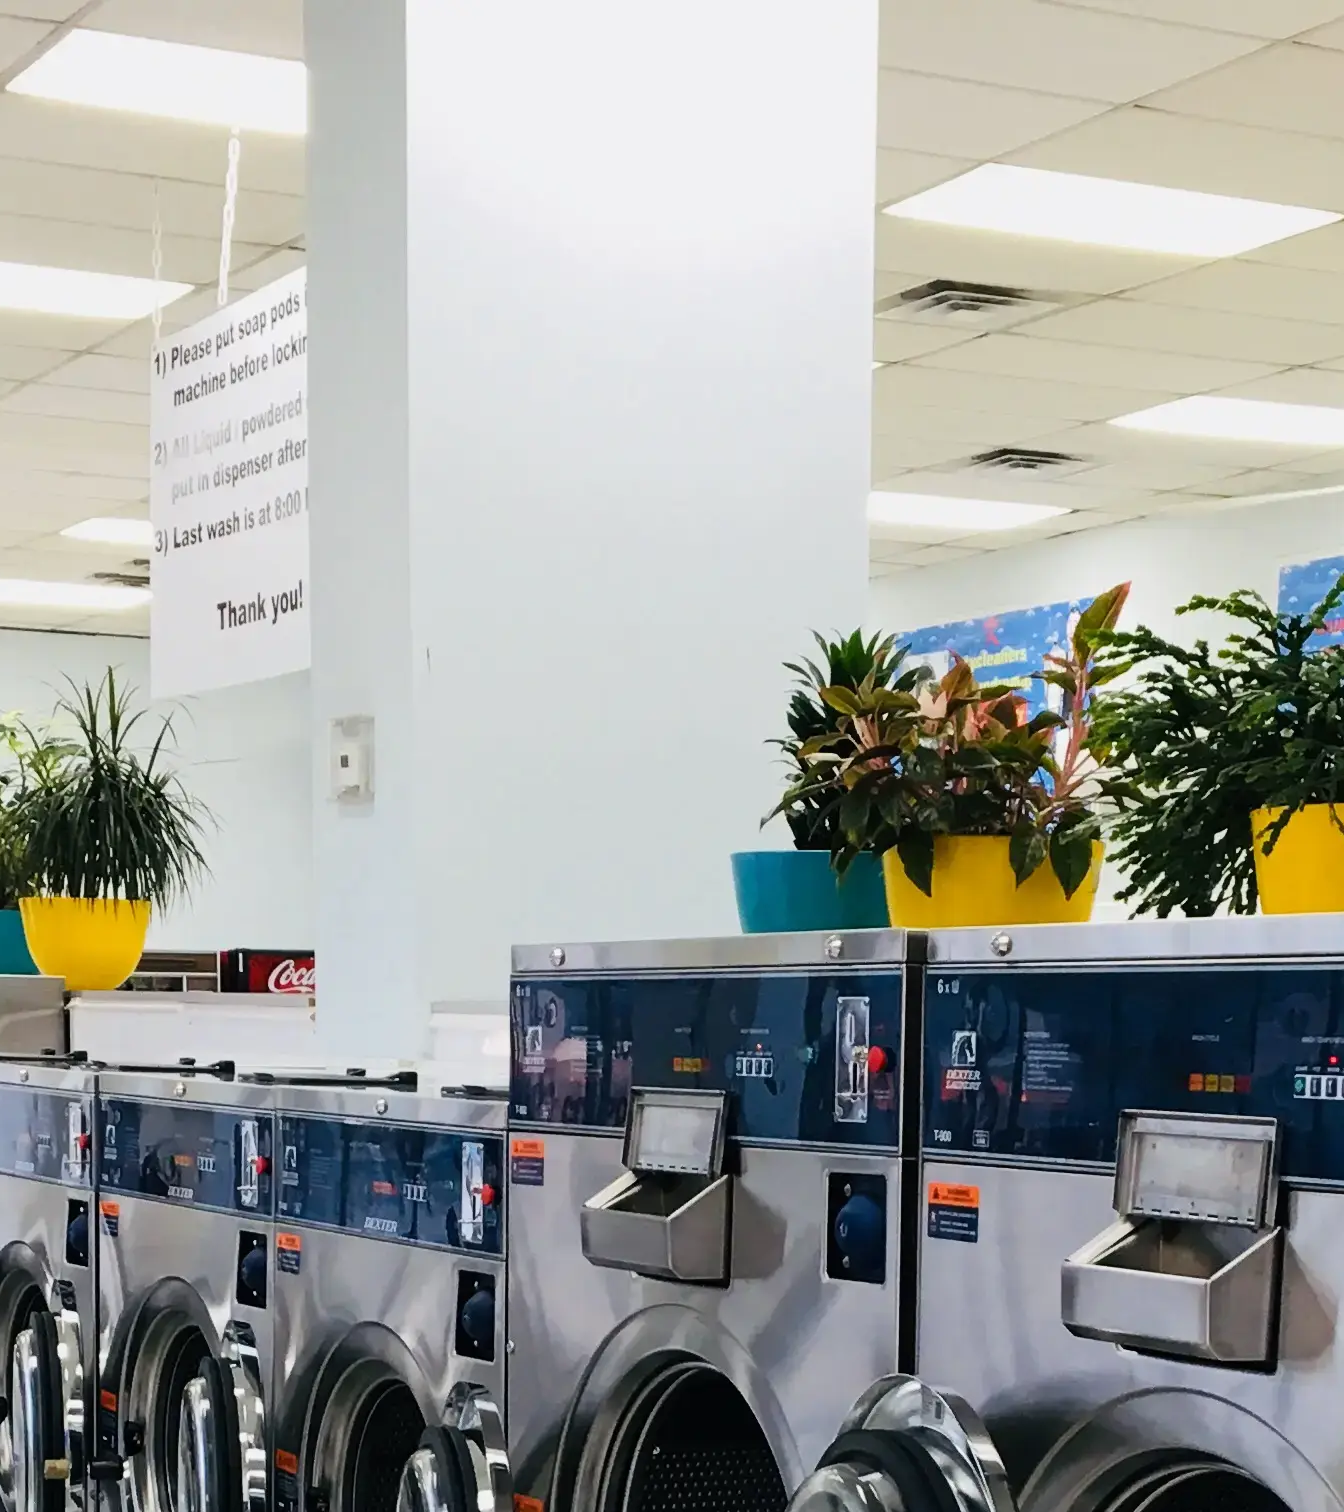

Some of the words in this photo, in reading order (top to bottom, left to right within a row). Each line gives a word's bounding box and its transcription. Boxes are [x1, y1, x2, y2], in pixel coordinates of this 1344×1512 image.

[154, 351, 167, 379] 1)
[171, 338, 212, 370] Please
[216, 323, 235, 357] put
[238, 311, 267, 340] soap
[271, 292, 300, 329] pods
[174, 372, 226, 407] machine
[230, 354, 268, 385] before
[194, 419, 232, 456] Liquid
[242, 391, 303, 442] powdered
[172, 476, 193, 504] put
[198, 471, 209, 491] in
[213, 451, 274, 488] dispenser
[277, 438, 307, 466] after
[154, 529, 168, 557] 3)
[173, 522, 203, 549] Last
[206, 511, 240, 540] wash
[244, 507, 255, 531] is
[258, 502, 271, 527] at
[275, 490, 301, 521] 8:00
[217, 592, 267, 630] Thank
[271, 579, 303, 625] you!
[363, 1216, 398, 1233] DEXTER
